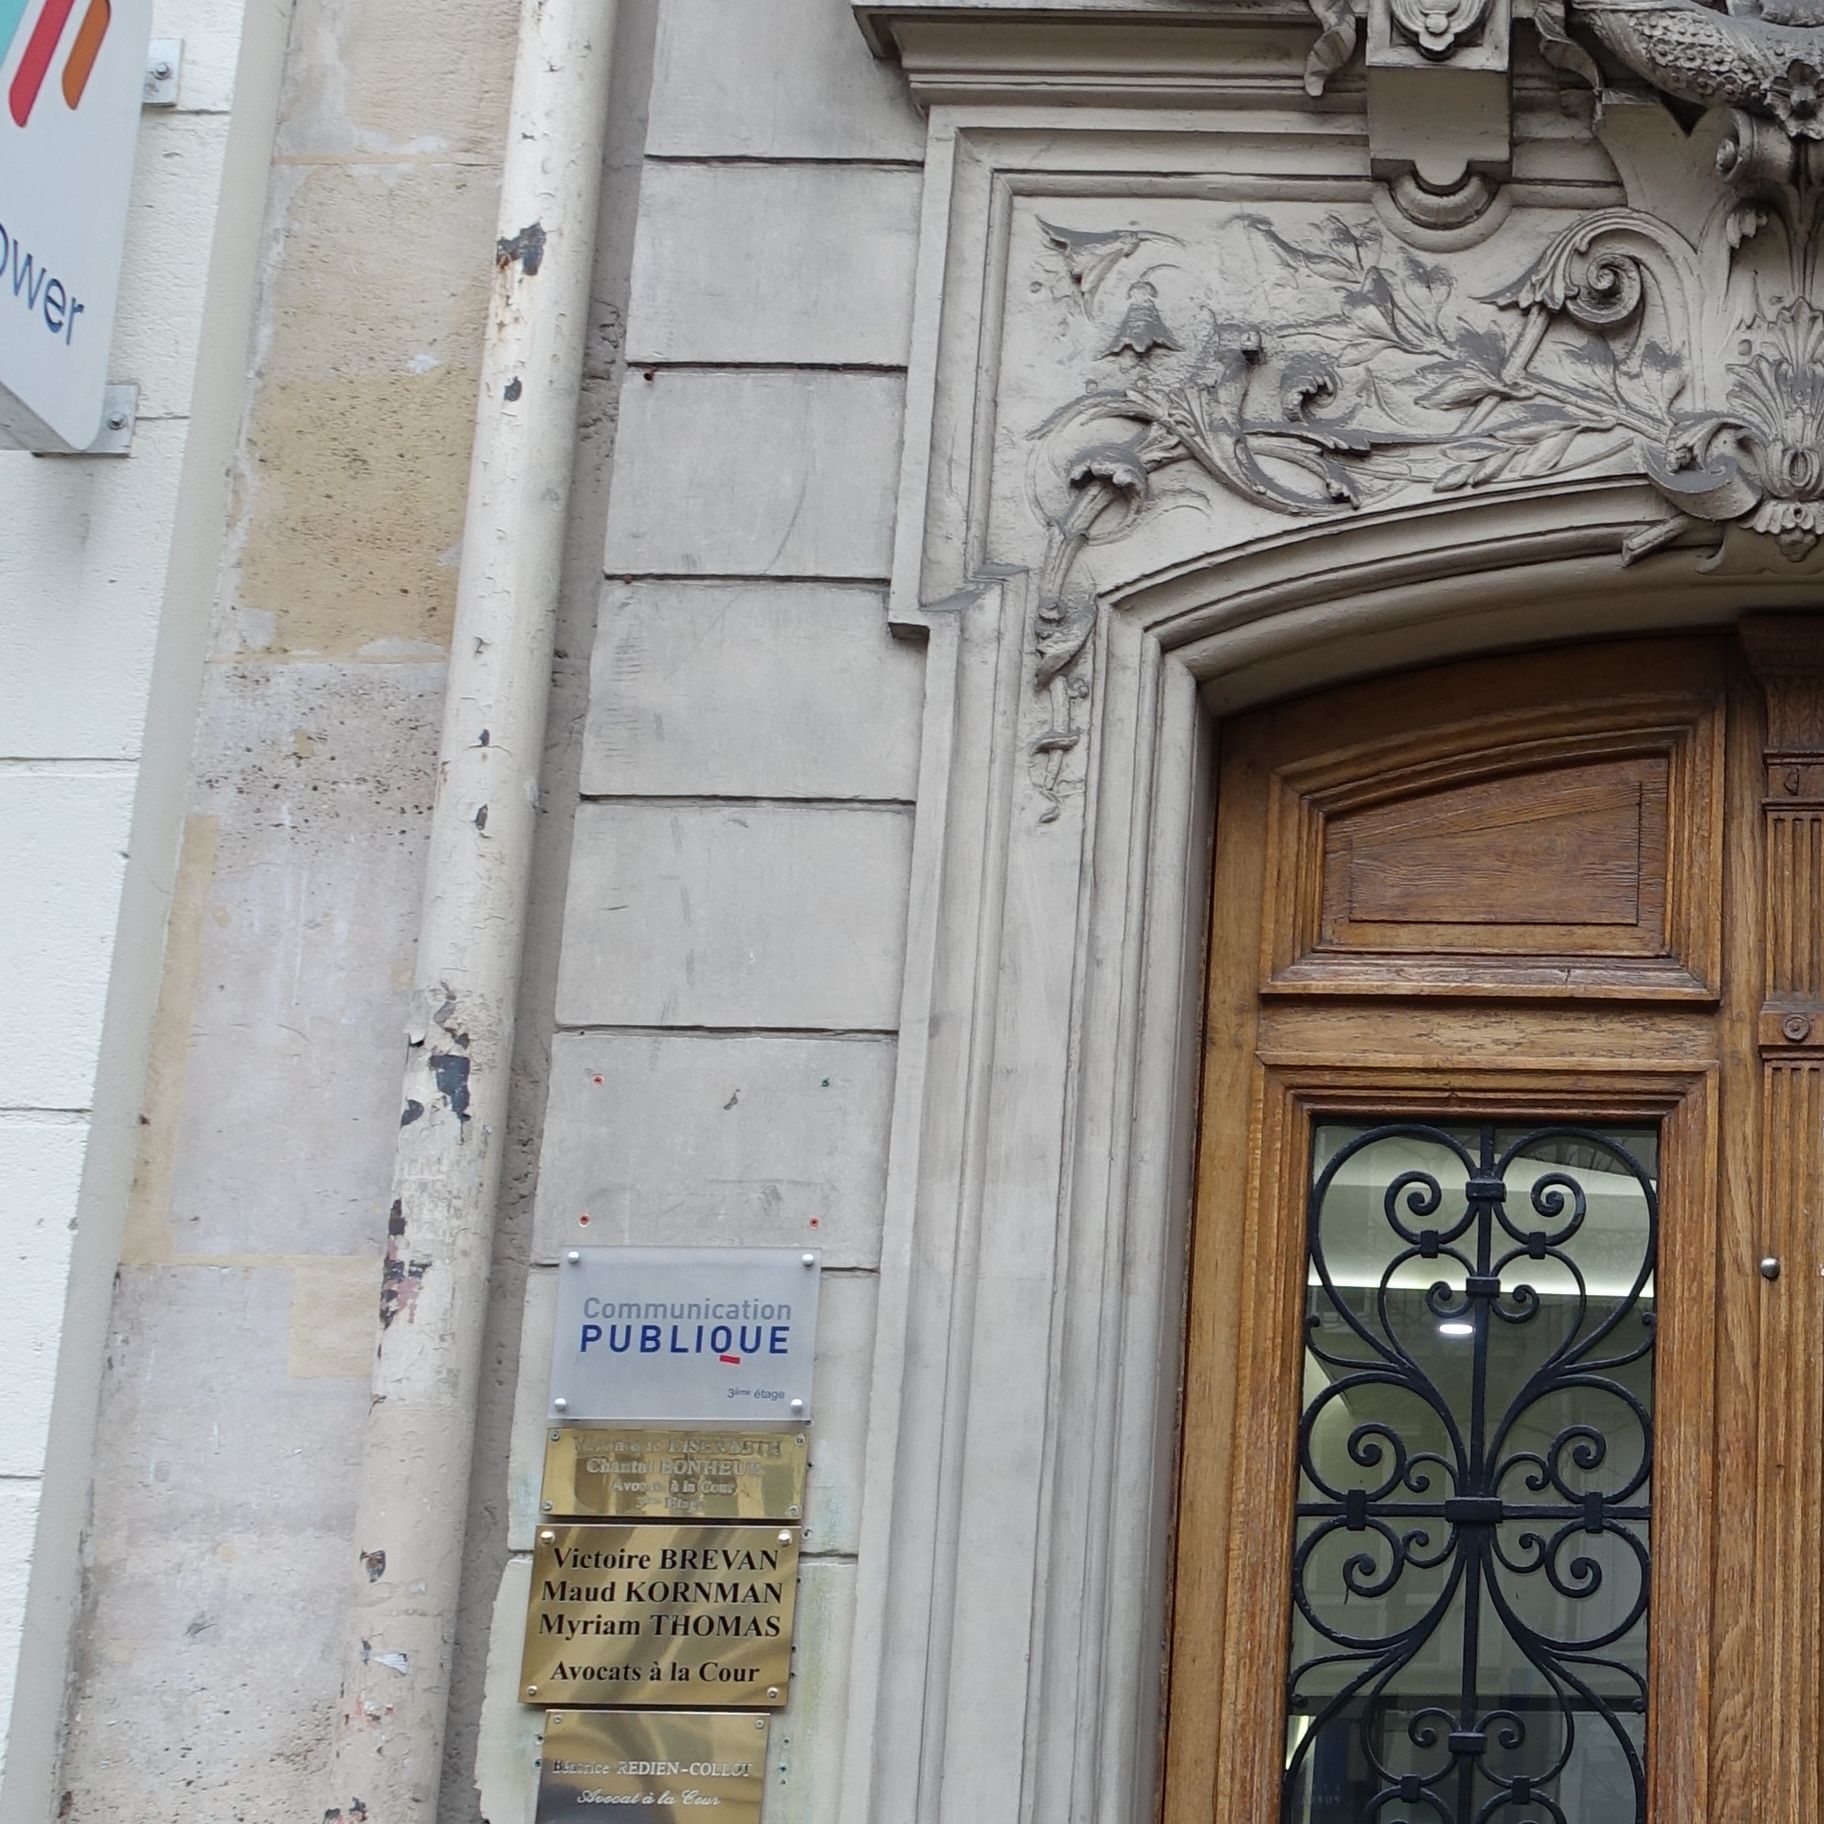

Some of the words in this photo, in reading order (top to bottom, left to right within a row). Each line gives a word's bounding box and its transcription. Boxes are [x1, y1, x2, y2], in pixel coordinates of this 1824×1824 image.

[583, 1296, 792, 1321] Communication
[579, 1324, 791, 1362] PUBLIQUE
[753, 1388, 786, 1402] étage
[700, 1479, 736, 1495] Cour
[553, 1547, 652, 1569] Victoire
[657, 1548, 779, 1571] BREVAN
[541, 1580, 616, 1603] Maud
[624, 1581, 784, 1605] KORNMAN
[538, 1613, 641, 1641] Myriam
[649, 1614, 781, 1638] THOMAS
[550, 1661, 642, 1682] Avocats
[649, 1661, 662, 1682] à
[670, 1662, 690, 1682] la
[698, 1661, 760, 1683] Cour
[576, 1788, 641, 1806] Avocat
[641, 1791, 655, 1806] à
[657, 1789, 677, 1806] la
